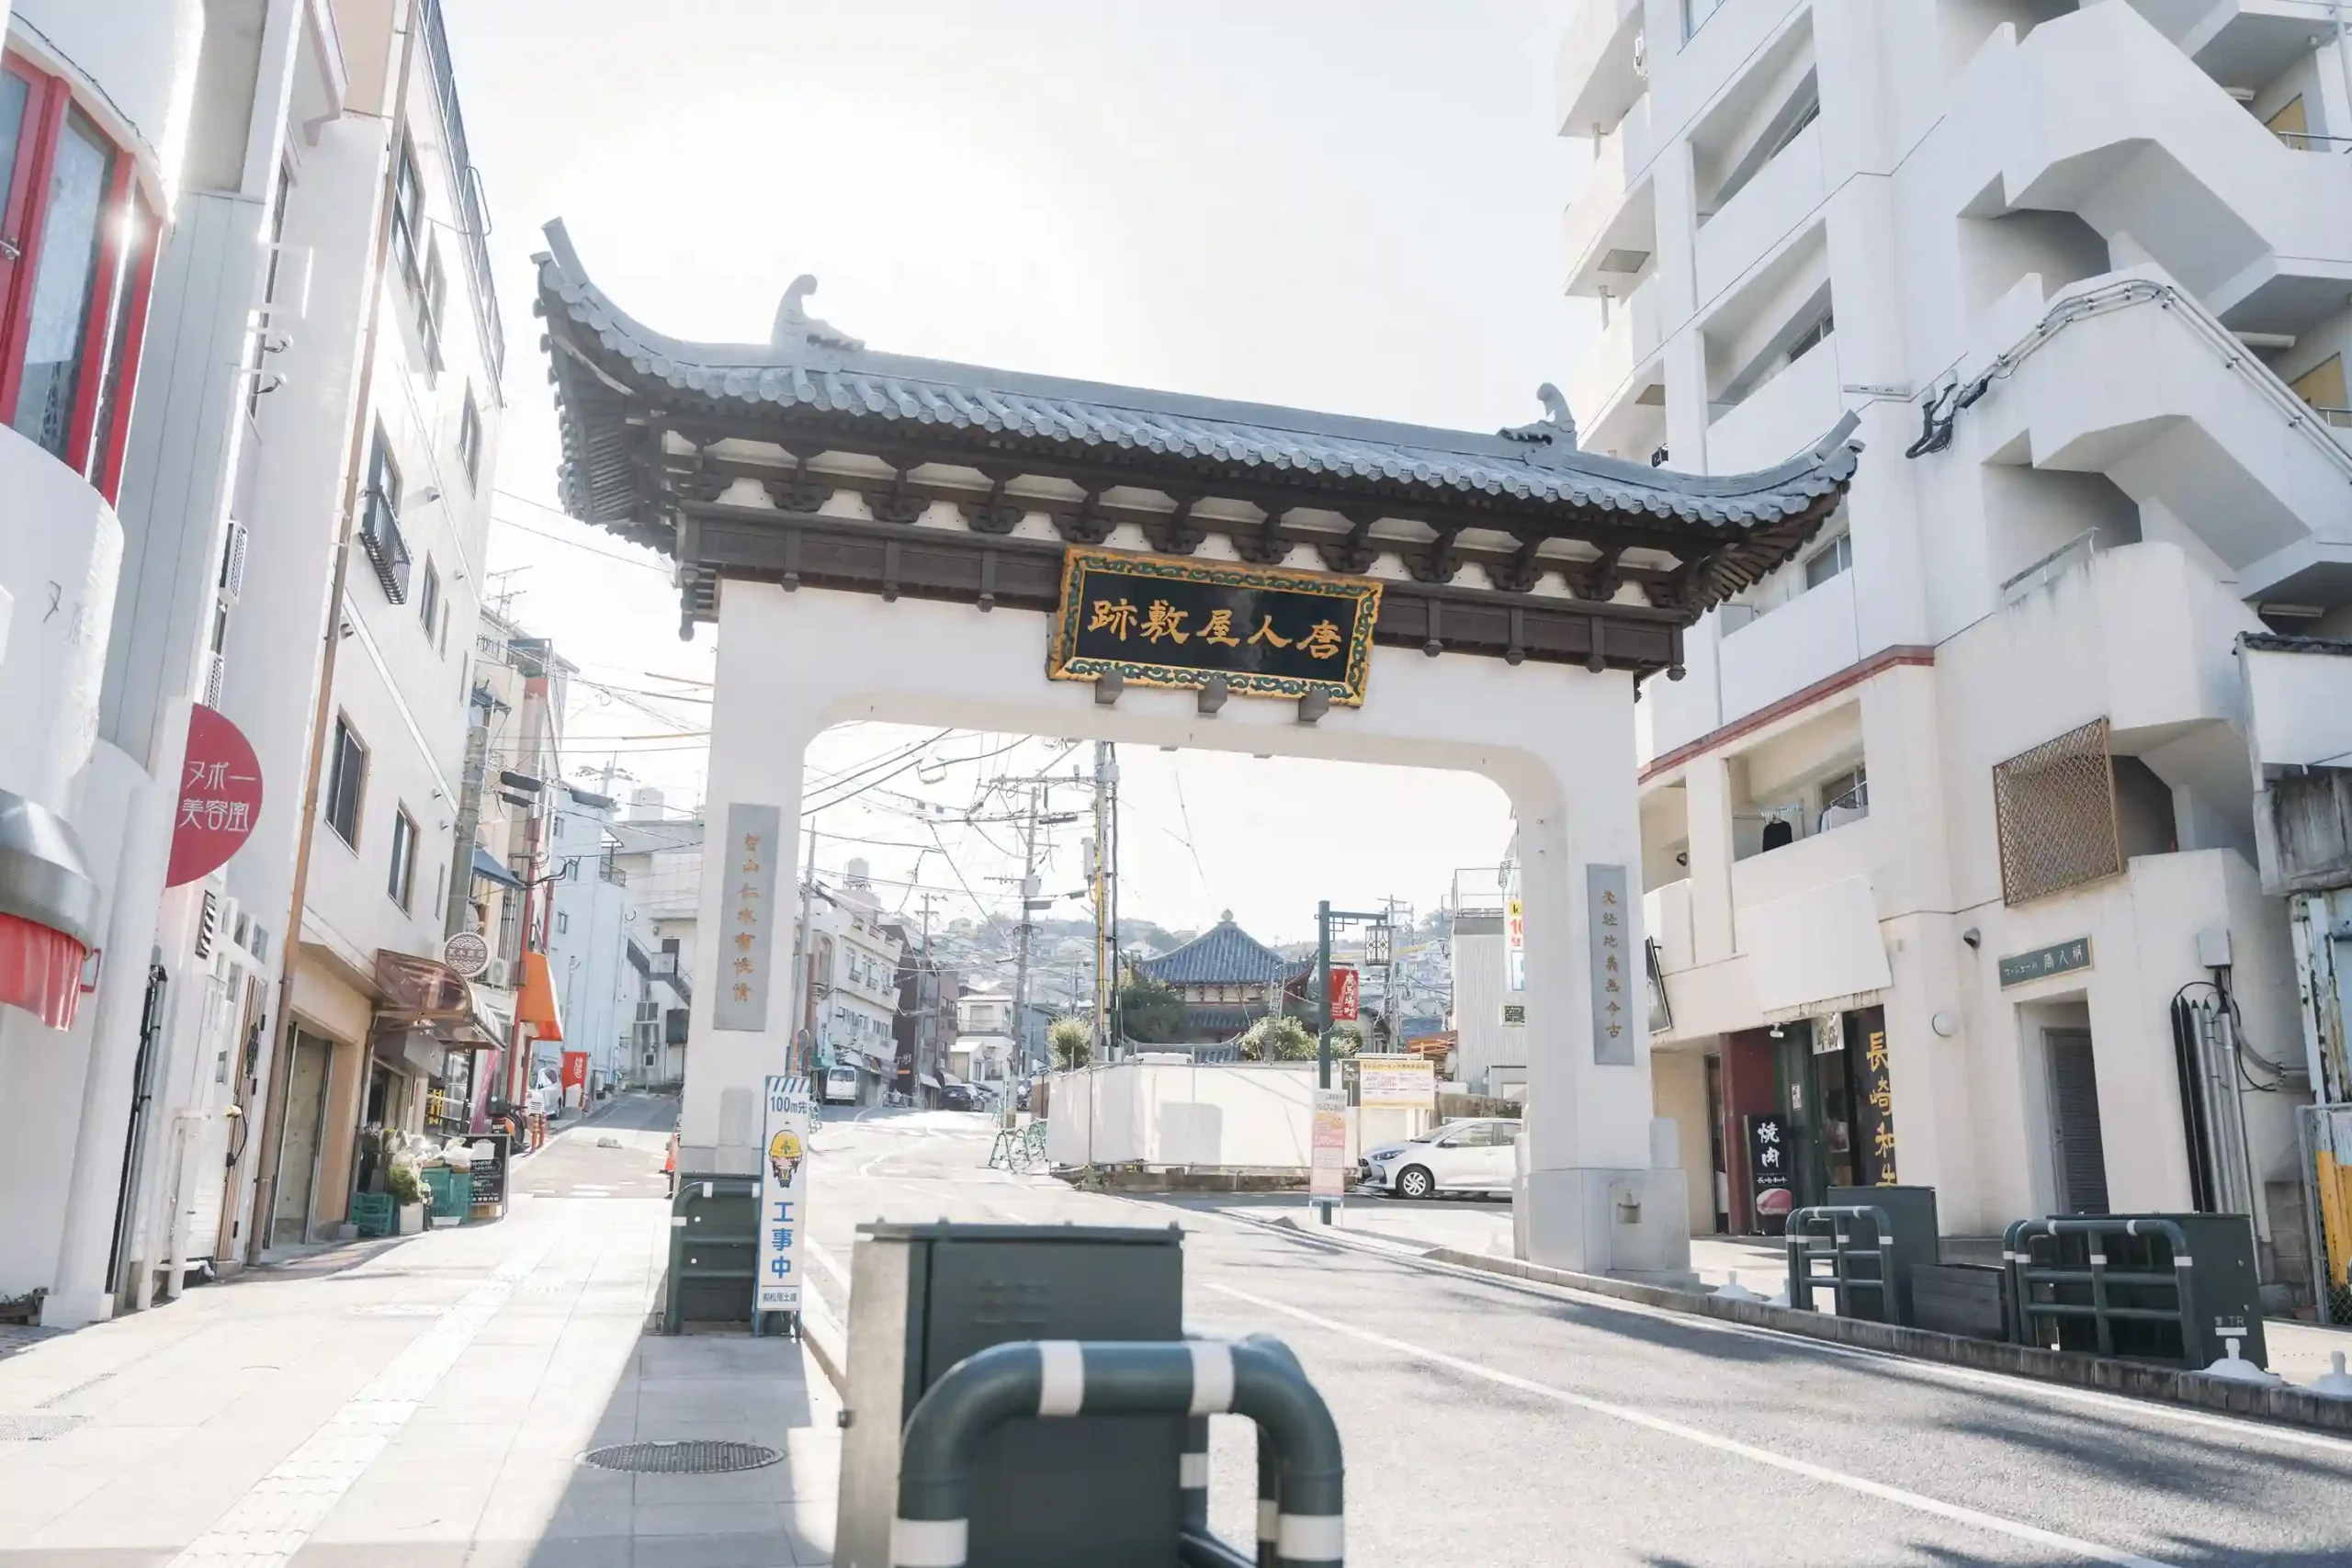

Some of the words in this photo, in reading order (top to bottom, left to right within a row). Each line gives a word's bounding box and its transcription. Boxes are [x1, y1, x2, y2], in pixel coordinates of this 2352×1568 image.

[187, 761, 256, 790] ヌボー
[1757, 1122, 1781, 1168] 焼肉
[771, 1201, 795, 1280] 工事中
